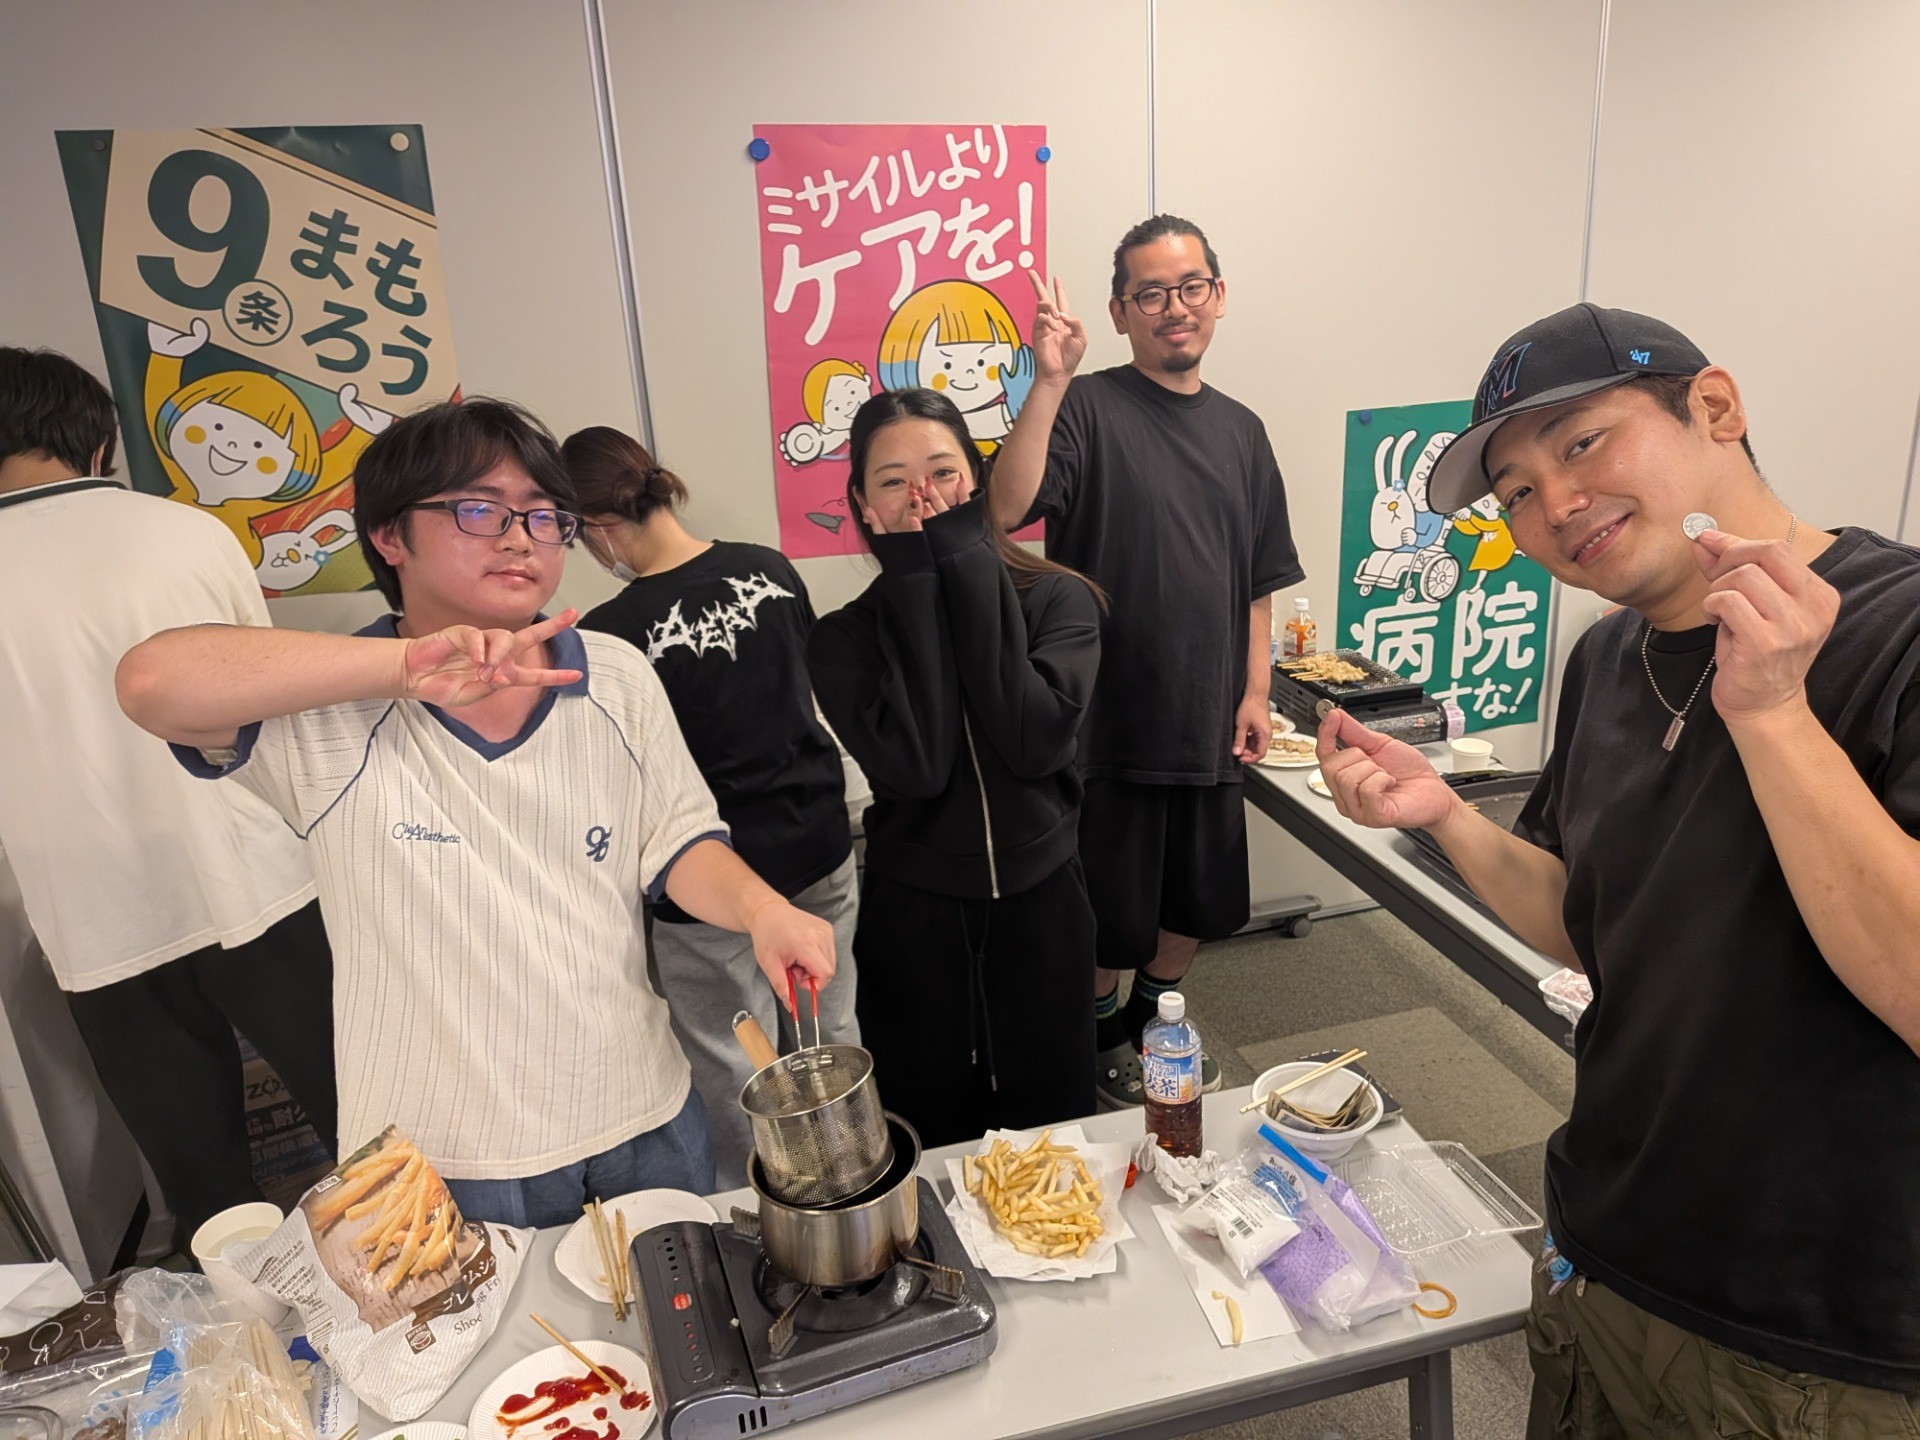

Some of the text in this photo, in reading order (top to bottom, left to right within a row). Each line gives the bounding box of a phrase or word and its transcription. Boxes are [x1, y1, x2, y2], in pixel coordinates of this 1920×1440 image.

[763, 124, 1008, 235] ミサイルより
[1350, 581, 1538, 684] 病院
